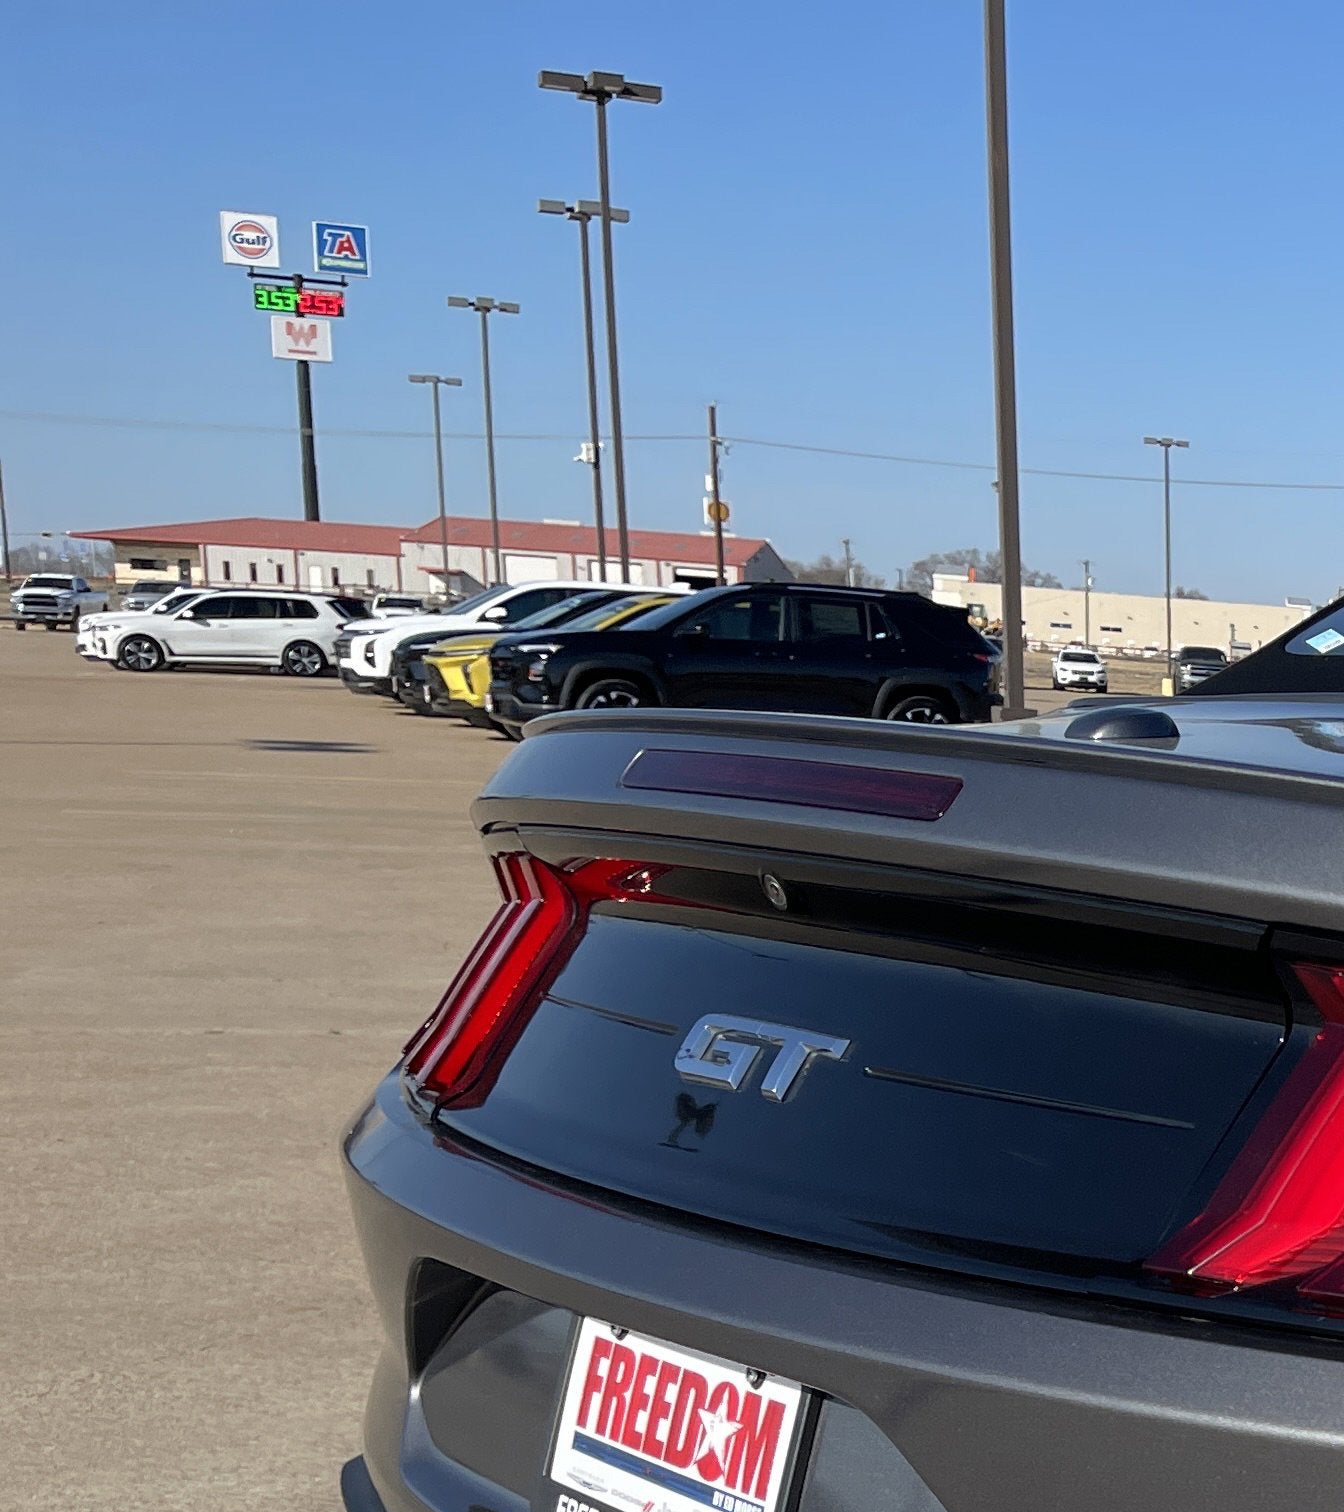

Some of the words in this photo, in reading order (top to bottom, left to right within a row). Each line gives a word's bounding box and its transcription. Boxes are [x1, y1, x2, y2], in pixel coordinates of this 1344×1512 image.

[231, 233, 268, 248] Gulf
[323, 229, 361, 259] TA
[674, 1013, 851, 1104] GT
[576, 1335, 786, 1502] FREEDOM
